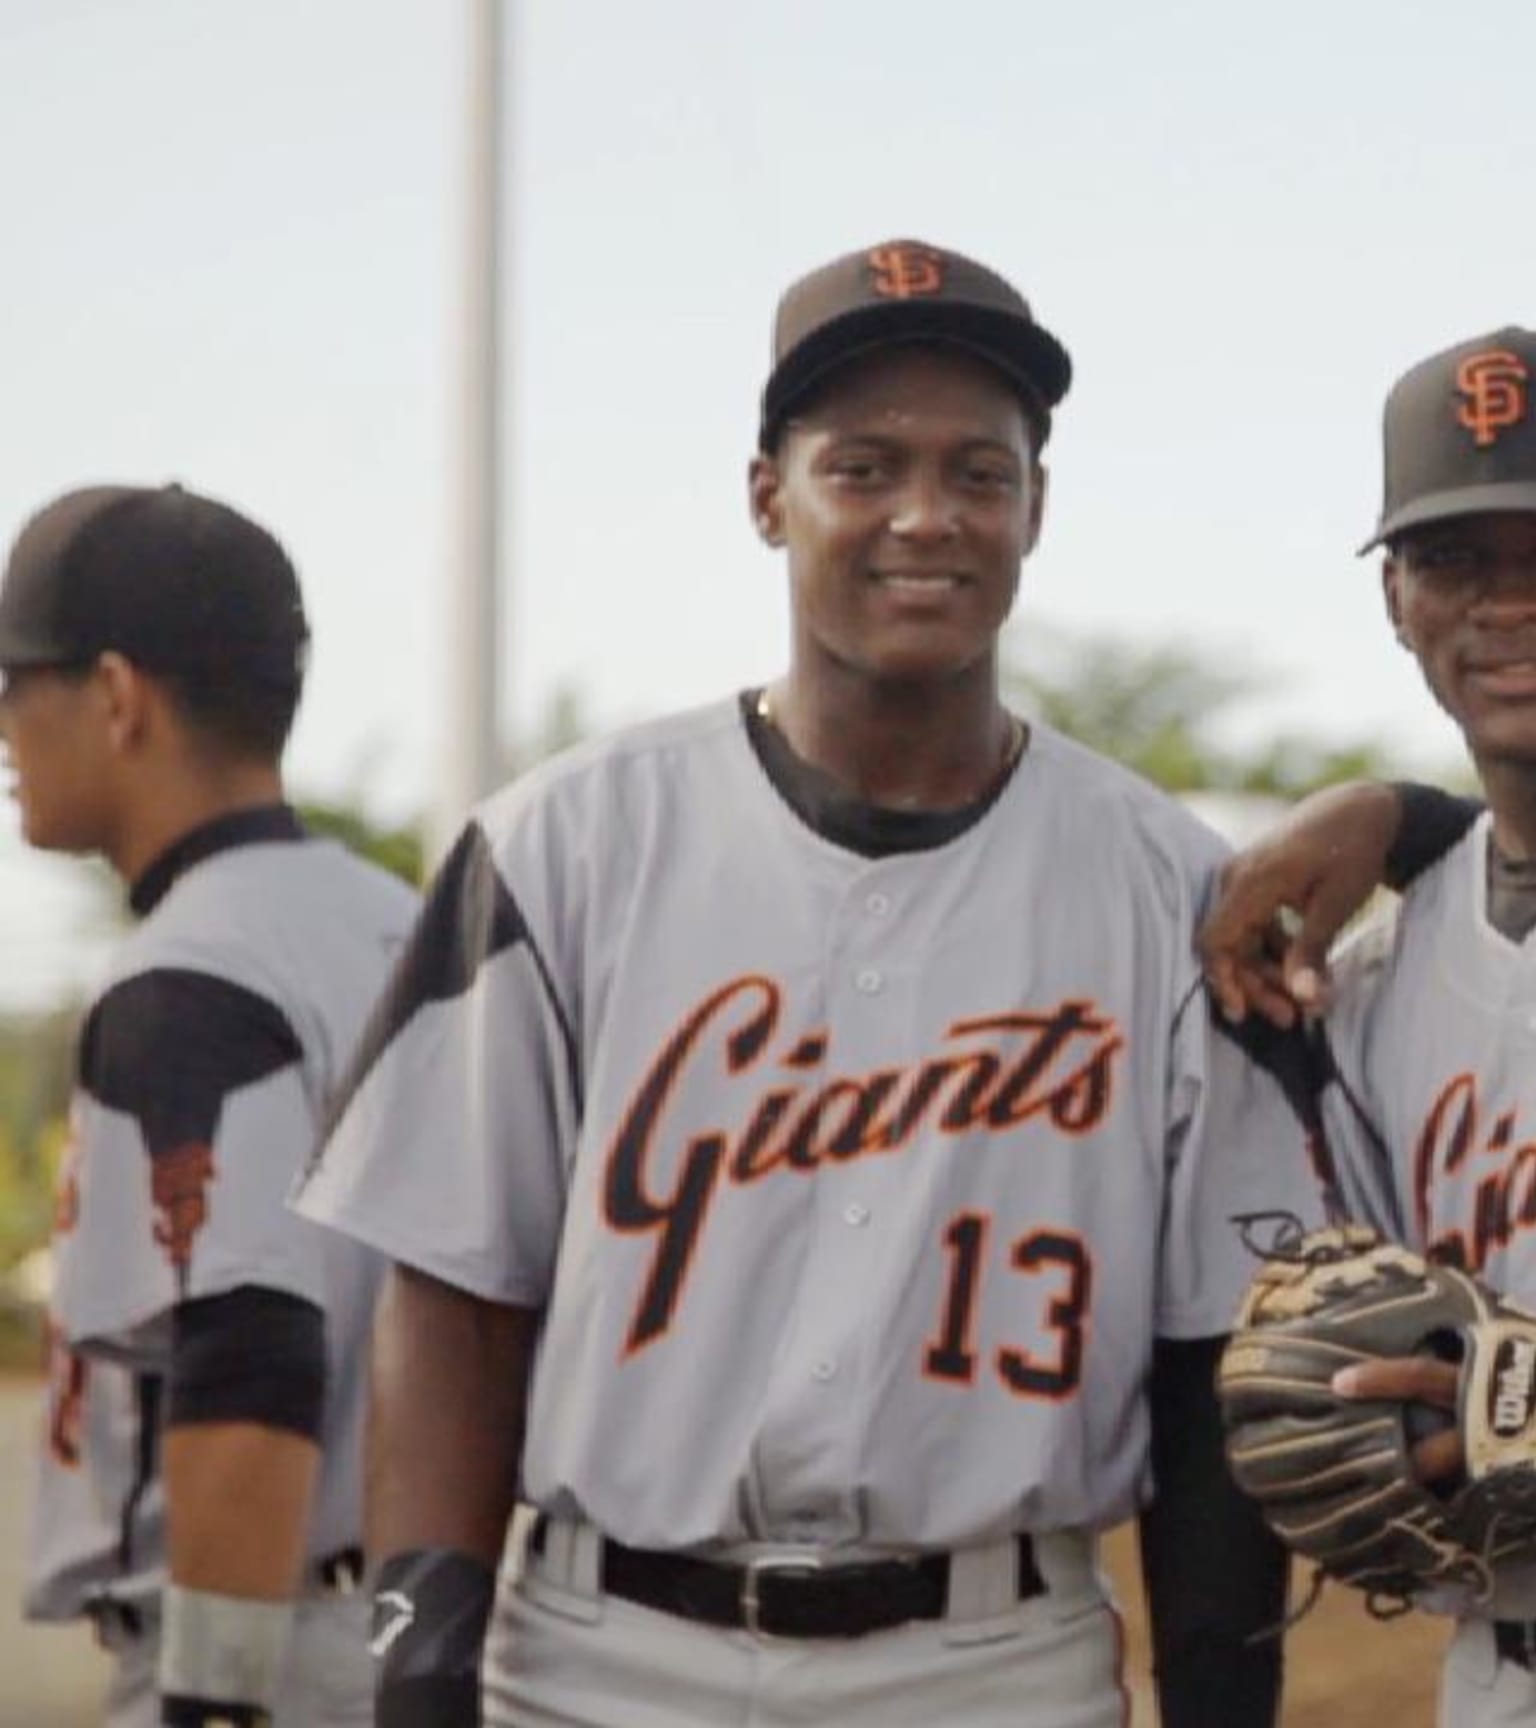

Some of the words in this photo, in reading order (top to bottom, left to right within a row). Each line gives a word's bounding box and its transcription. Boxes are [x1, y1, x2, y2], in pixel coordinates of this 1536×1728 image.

[1456, 349, 1528, 446] SF
[602, 974, 1126, 1364] Giants
[922, 1206, 1094, 1402] 13
